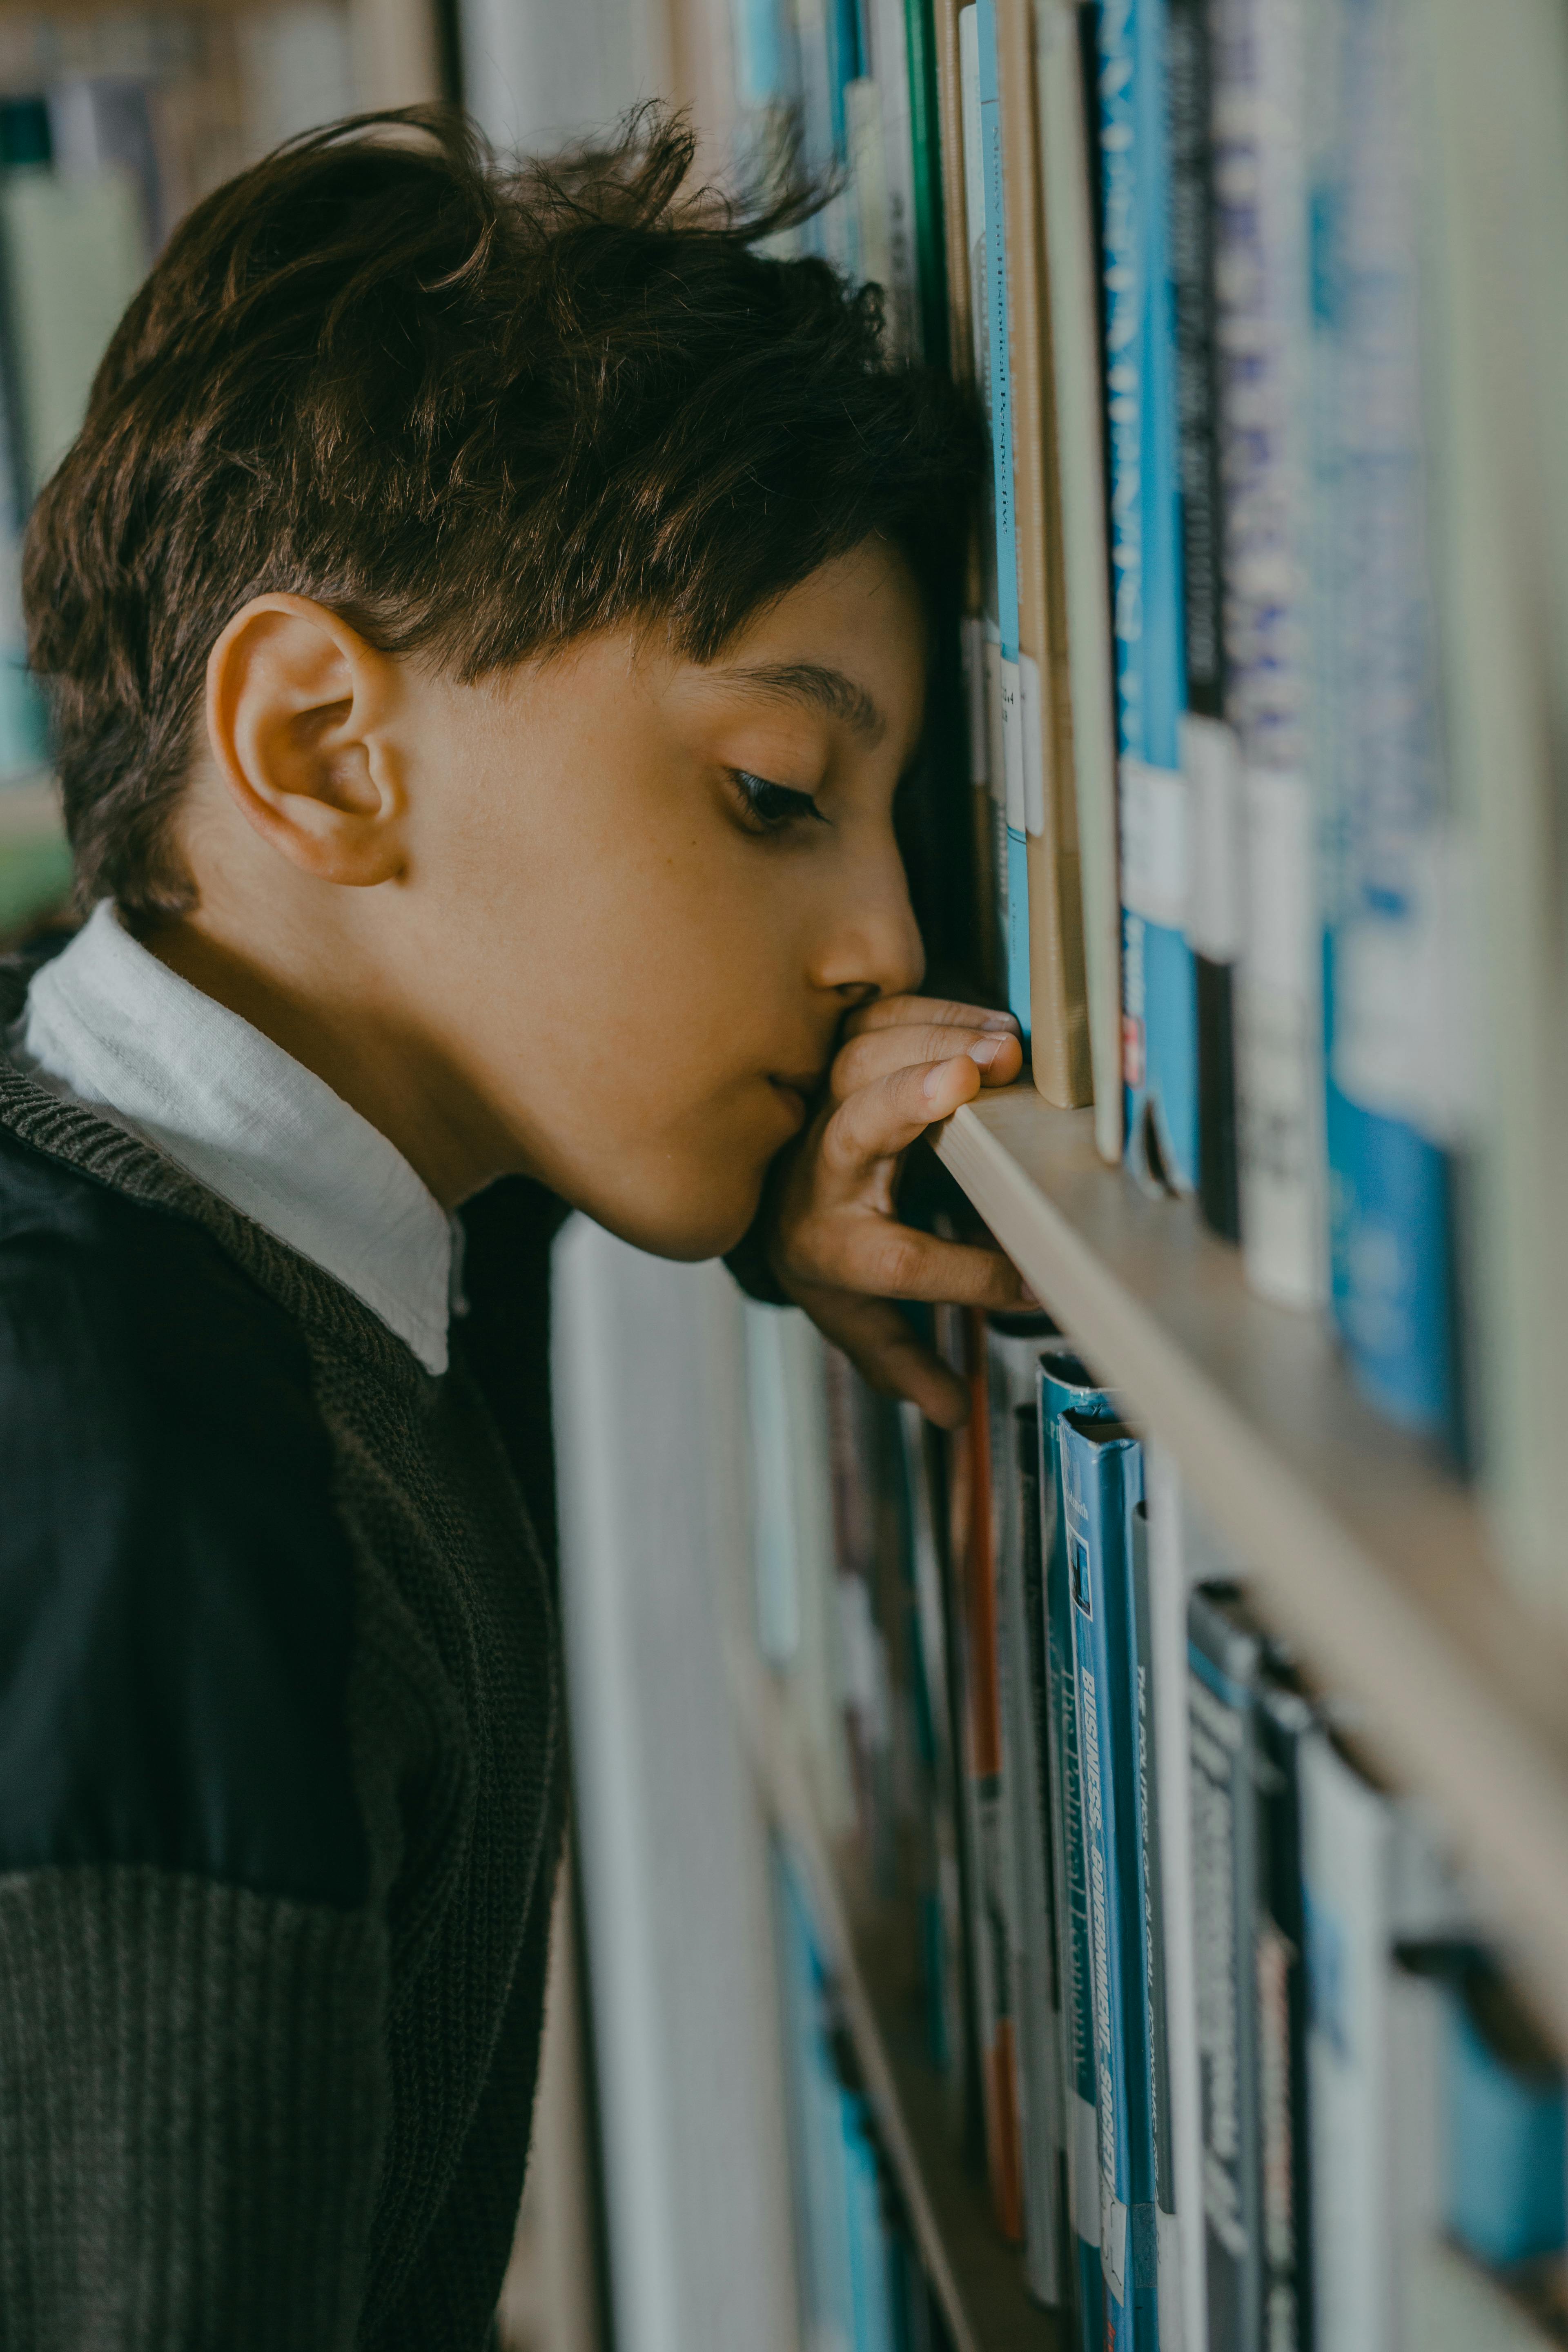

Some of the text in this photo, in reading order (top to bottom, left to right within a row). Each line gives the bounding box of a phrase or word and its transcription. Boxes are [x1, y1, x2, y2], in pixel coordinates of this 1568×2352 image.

[992, 126, 1009, 534] Money in Historical Perspective
[1137, 1664, 1146, 1716] THE
[1064, 1746, 1085, 1897] Political
[1139, 1721, 1149, 1844] POLITICS
[1143, 1848, 1149, 1889] OF
[1068, 1904, 1088, 2078] Economy
[1145, 1893, 1154, 1987] GLOBAL
[1100, 2064, 1115, 2196] SOCIETY
[1148, 1999, 1157, 2133] ECONOMIC
